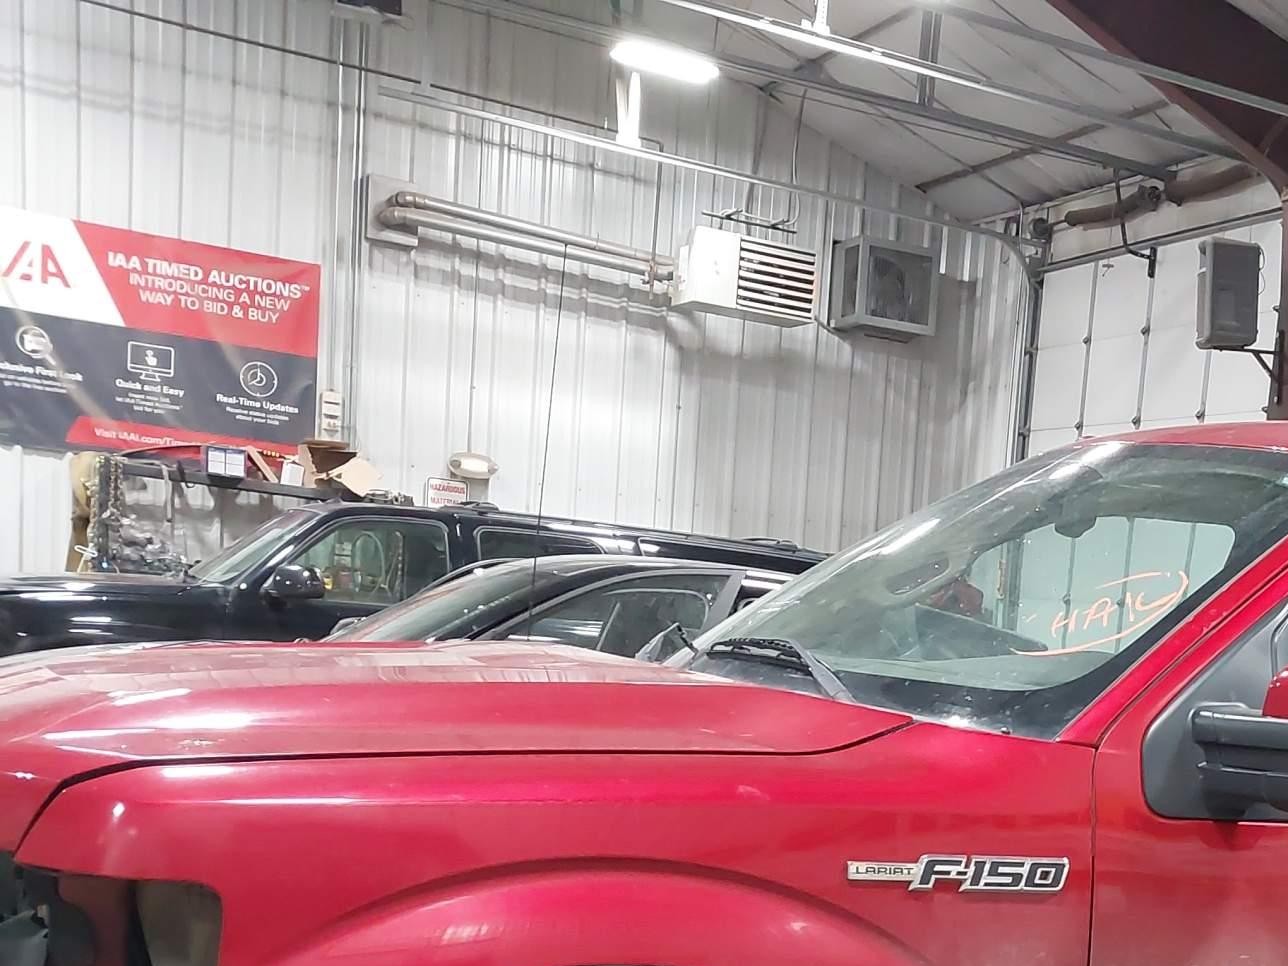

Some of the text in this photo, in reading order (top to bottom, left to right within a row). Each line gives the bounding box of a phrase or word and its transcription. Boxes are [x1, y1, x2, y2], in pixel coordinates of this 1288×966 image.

[108, 251, 142, 271] IAA
[144, 258, 203, 281] TIMED
[129, 272, 290, 311] INTRODUCING A NEW
[138, 289, 280, 324] WAY TO BID & BUY
[163, 386, 185, 398] Easy
[216, 393, 299, 413] Real-Time Updates
[855, 855, 1069, 890] LARIAT F-150
